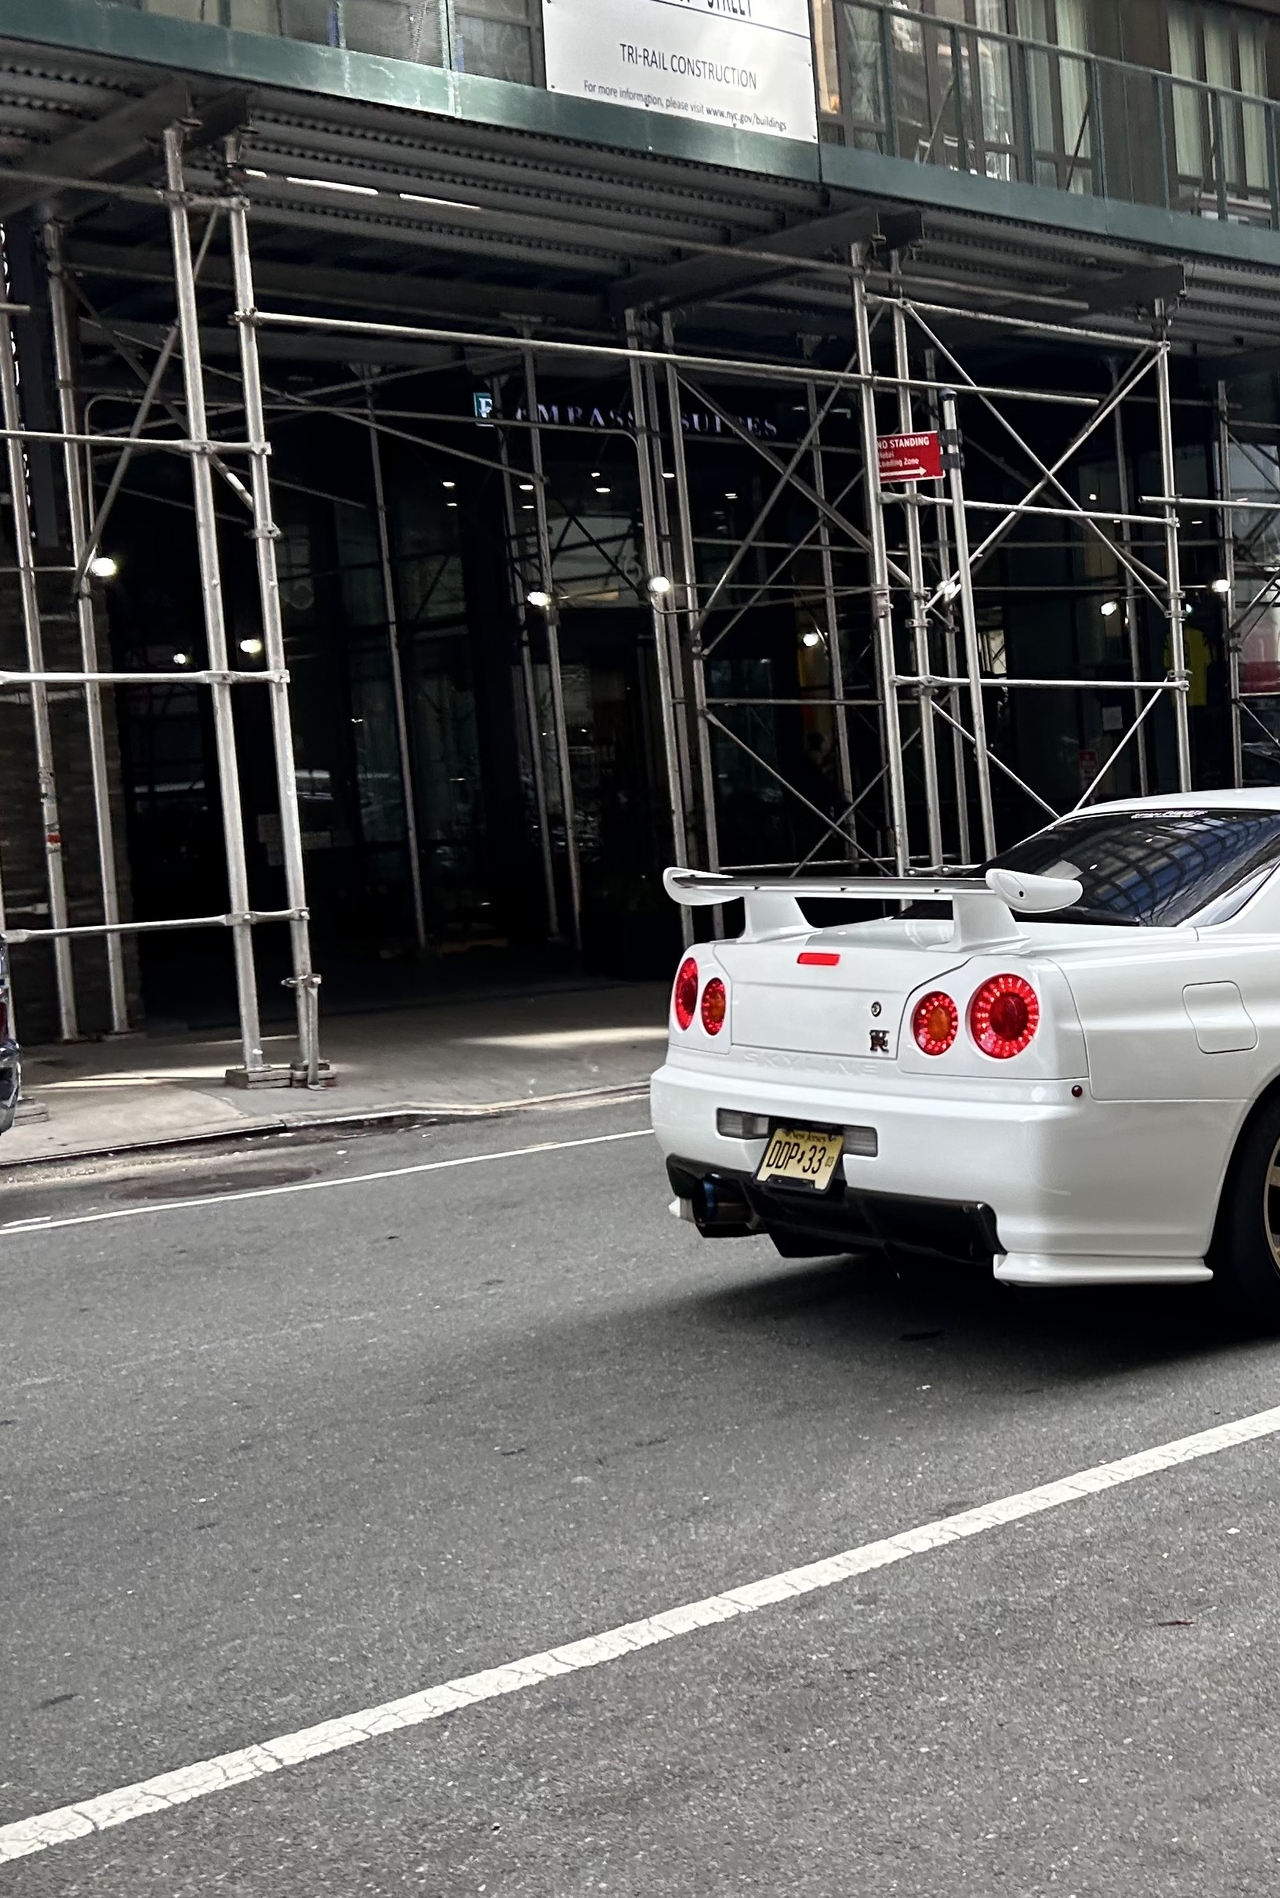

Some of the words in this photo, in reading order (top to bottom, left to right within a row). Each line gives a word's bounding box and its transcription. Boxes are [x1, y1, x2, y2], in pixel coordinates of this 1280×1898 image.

[619, 43, 668, 71] TRI-RAIL
[670, 54, 757, 90] CONSTRUCTION
[583, 79, 596, 93] For
[598, 86, 618, 97] more
[619, 87, 664, 108] information,
[665, 96, 689, 113] please
[690, 101, 705, 115] visit
[706, 105, 787, 131] www.nyc.gov/buildings
[890, 436, 930, 448] STANDING
[904, 457, 919, 465] Zone
